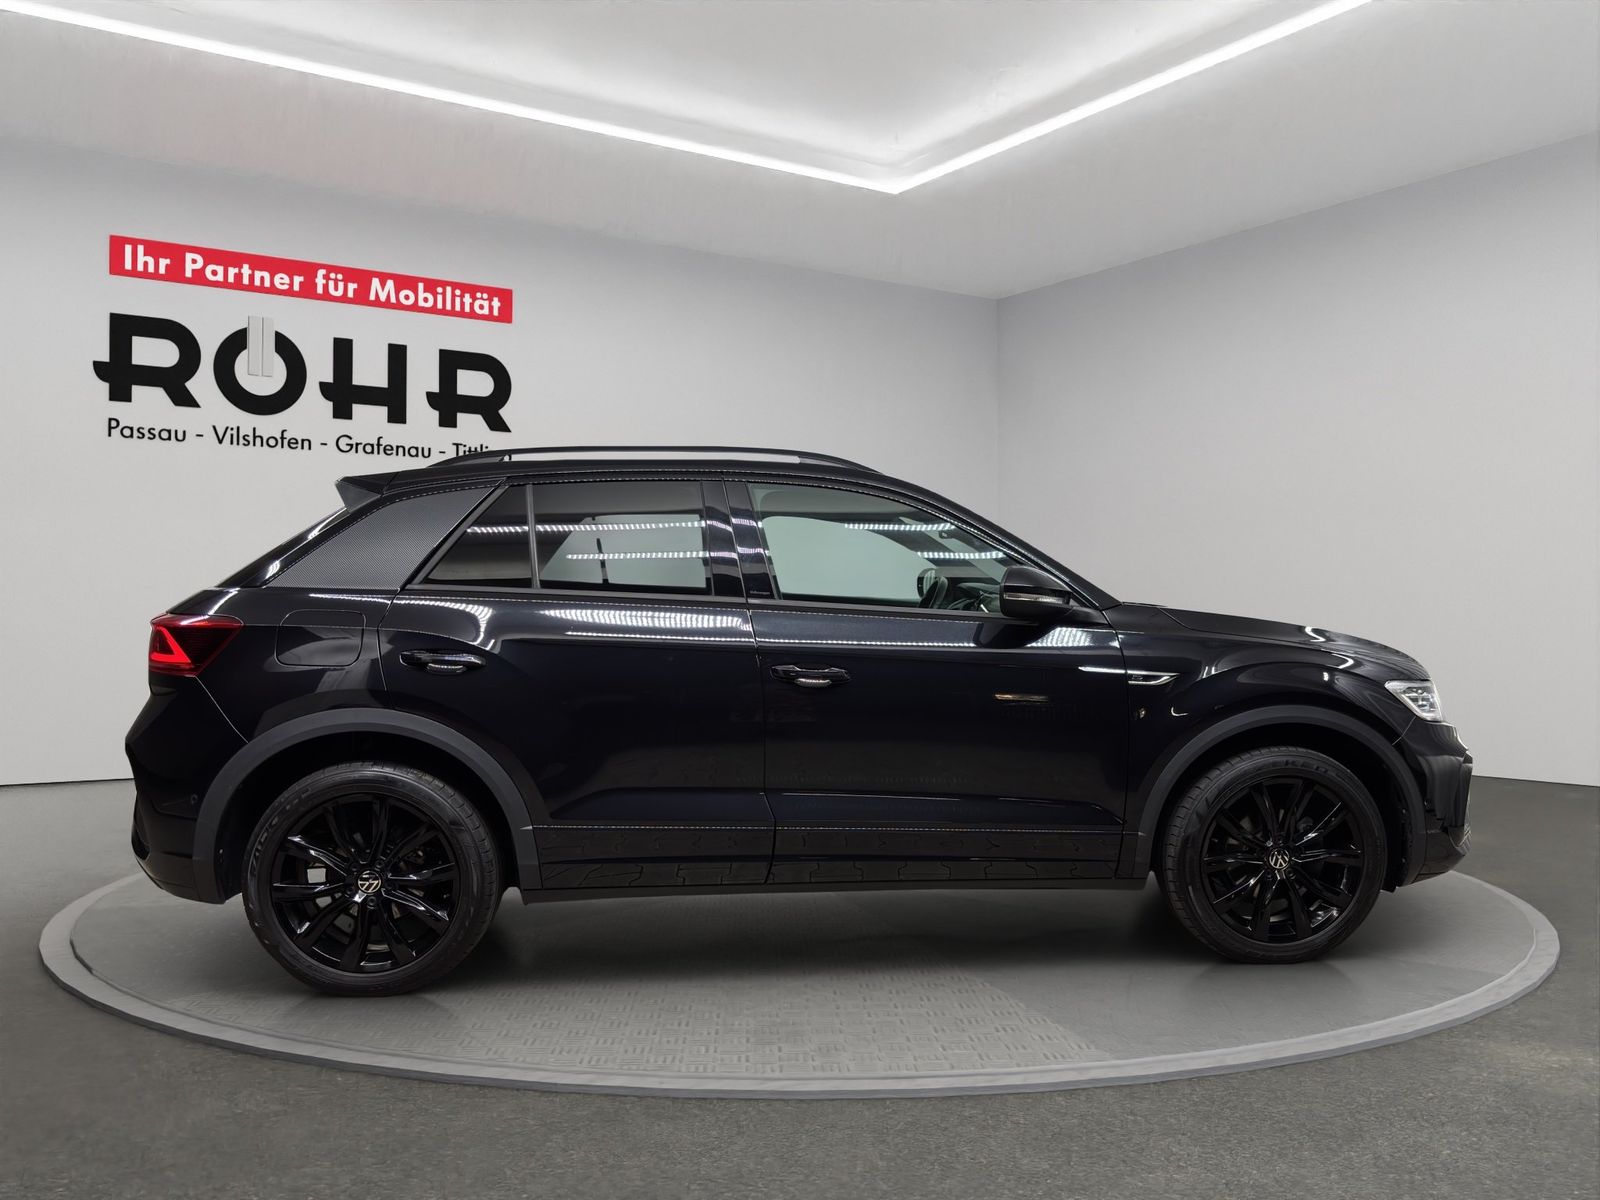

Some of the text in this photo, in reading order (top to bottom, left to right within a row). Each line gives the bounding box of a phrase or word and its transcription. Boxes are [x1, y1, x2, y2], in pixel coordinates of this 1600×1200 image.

[125, 244, 501, 317] Ihr Partner für Mobilität
[107, 418, 187, 443] Passau
[213, 425, 312, 451] Vilshofen
[335, 434, 432, 459] Grafenau
